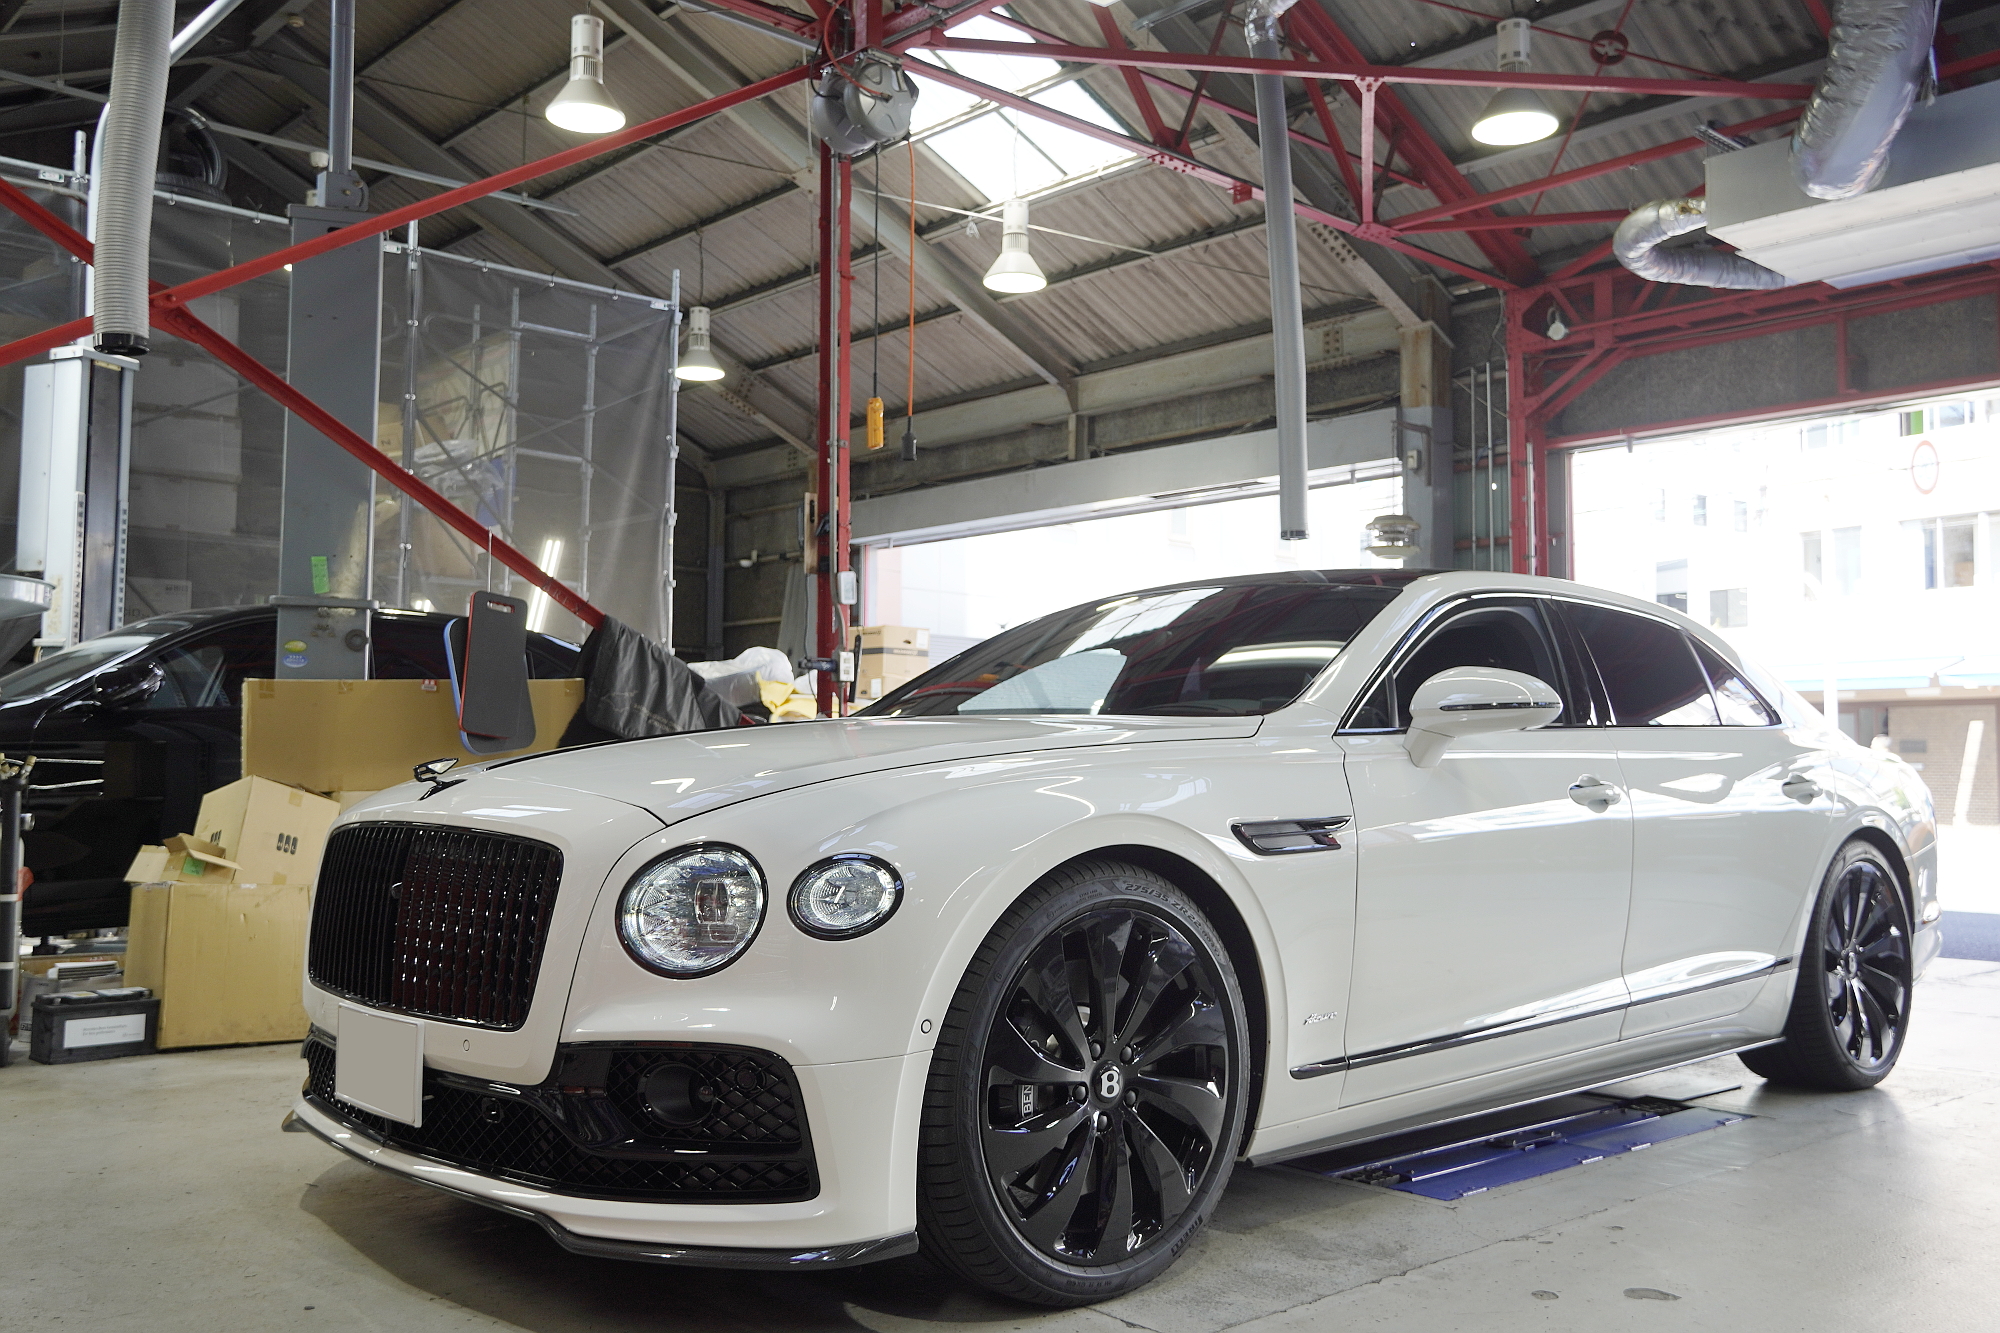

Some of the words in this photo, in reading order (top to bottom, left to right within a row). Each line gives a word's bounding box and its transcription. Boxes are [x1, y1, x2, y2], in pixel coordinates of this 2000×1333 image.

[1124, 883, 1169, 902] 275/35
[1171, 900, 1188, 915] ZR
[1188, 914, 1201, 928] 22
[1100, 1070, 1120, 1098] B
